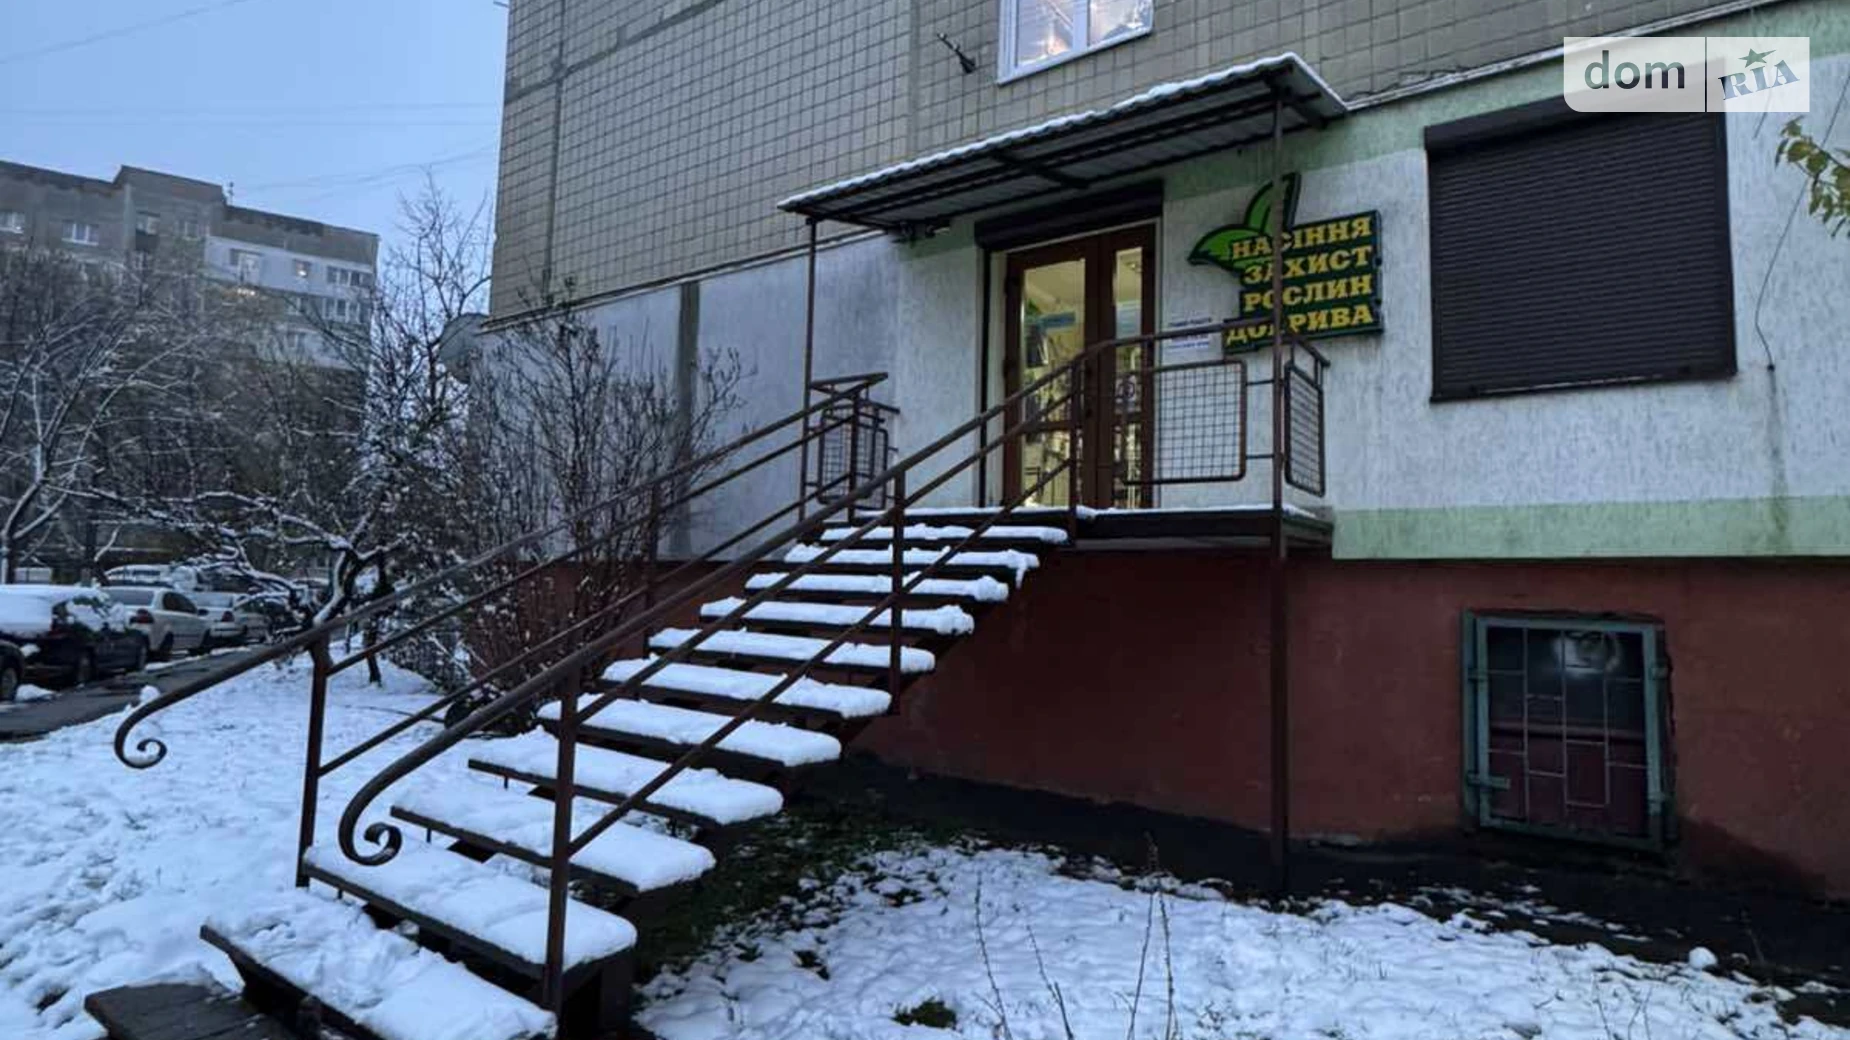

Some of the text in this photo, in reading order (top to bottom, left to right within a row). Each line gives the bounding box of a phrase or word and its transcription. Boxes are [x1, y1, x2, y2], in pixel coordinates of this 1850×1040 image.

[1232, 216, 1372, 259] НАСІННЯ
[1244, 274, 1372, 312] РОСЛИН
[1227, 305, 1373, 344] ДОРИВА
